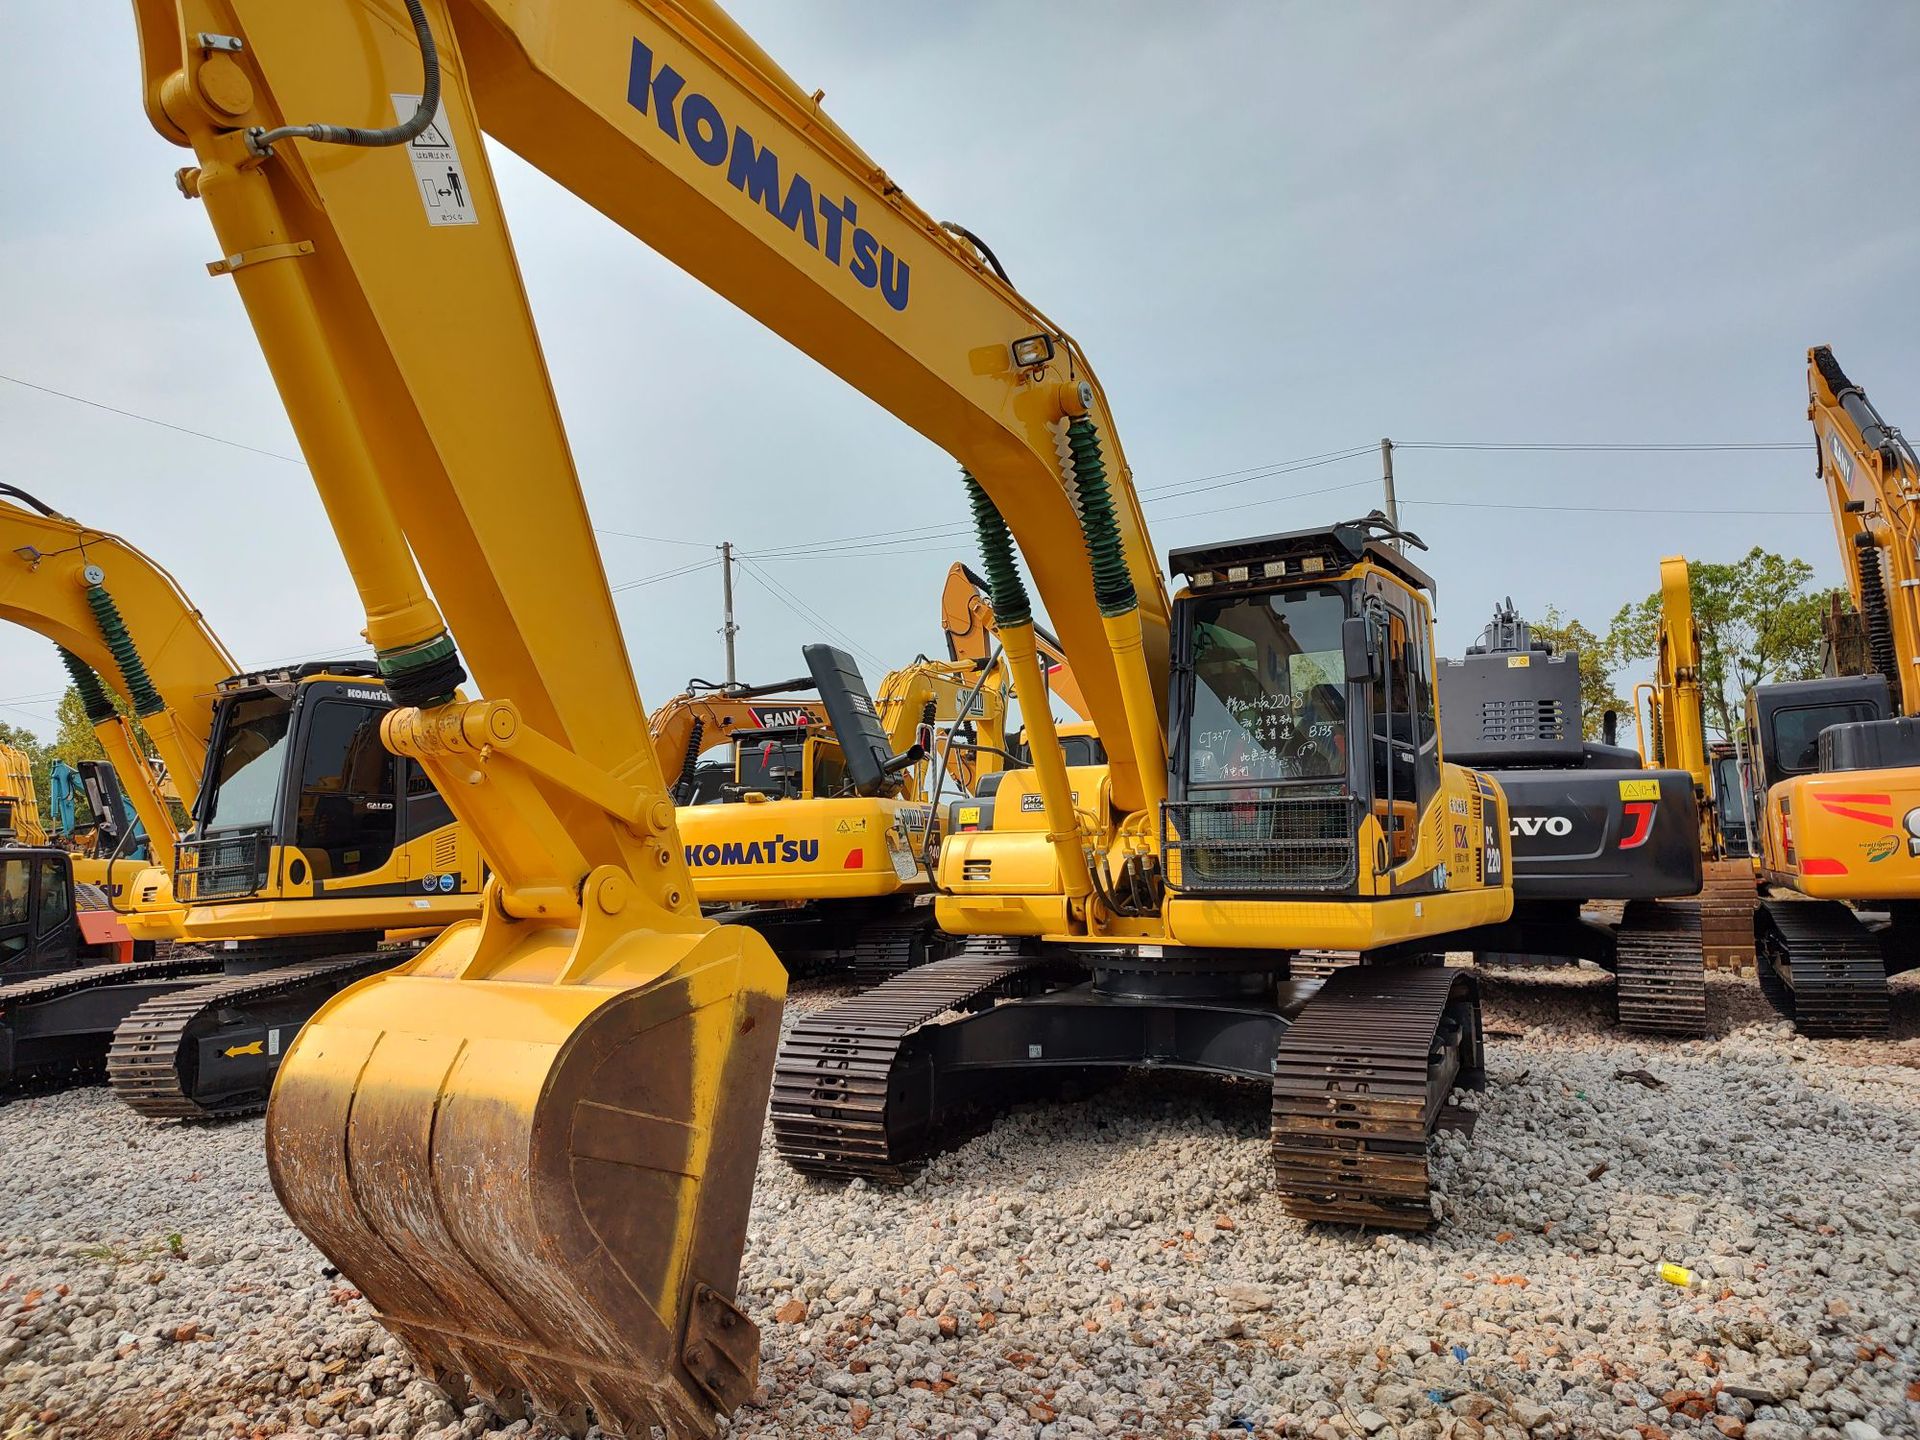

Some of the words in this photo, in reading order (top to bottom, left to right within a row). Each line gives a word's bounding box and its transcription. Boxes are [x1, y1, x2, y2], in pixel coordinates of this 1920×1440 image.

[627, 36, 910, 312] KOMATSU
[764, 710, 802, 728] SANY
[685, 834, 819, 867] KOMATSU
[1486, 848, 1501, 873] 220
